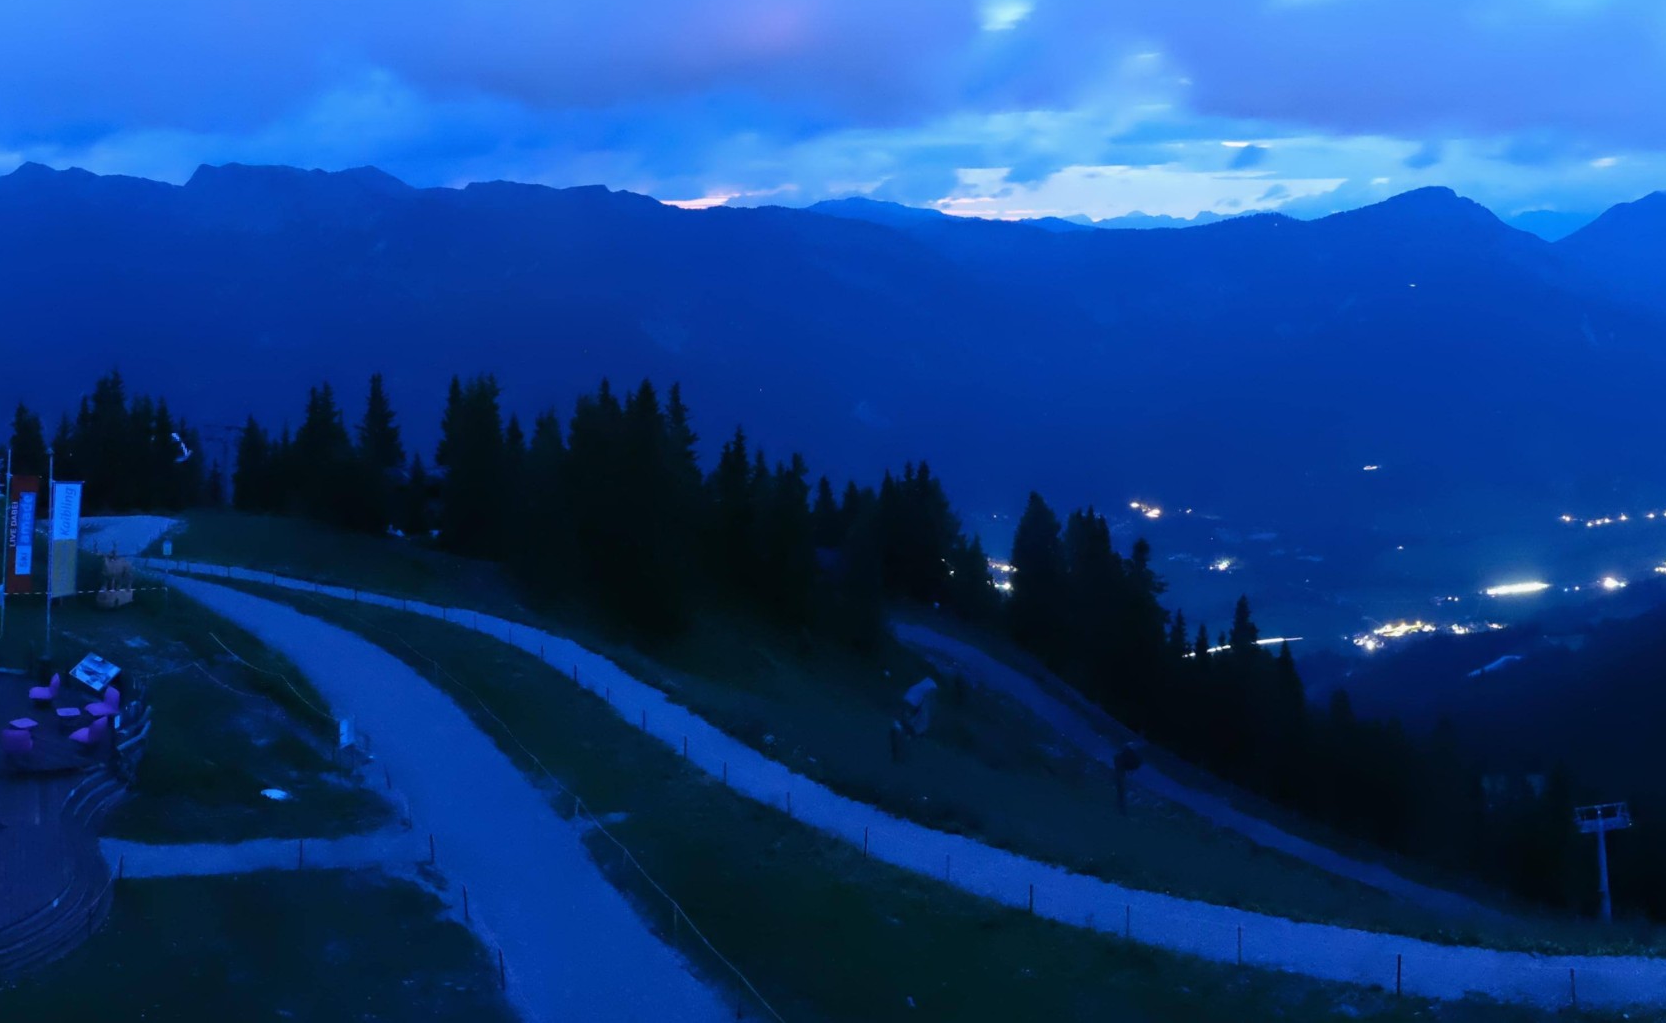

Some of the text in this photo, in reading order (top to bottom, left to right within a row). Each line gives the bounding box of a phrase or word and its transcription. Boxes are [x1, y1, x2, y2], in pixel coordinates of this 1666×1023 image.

[9, 501, 19, 548] LIVE DABEI
[59, 487, 76, 536] Kaibling
